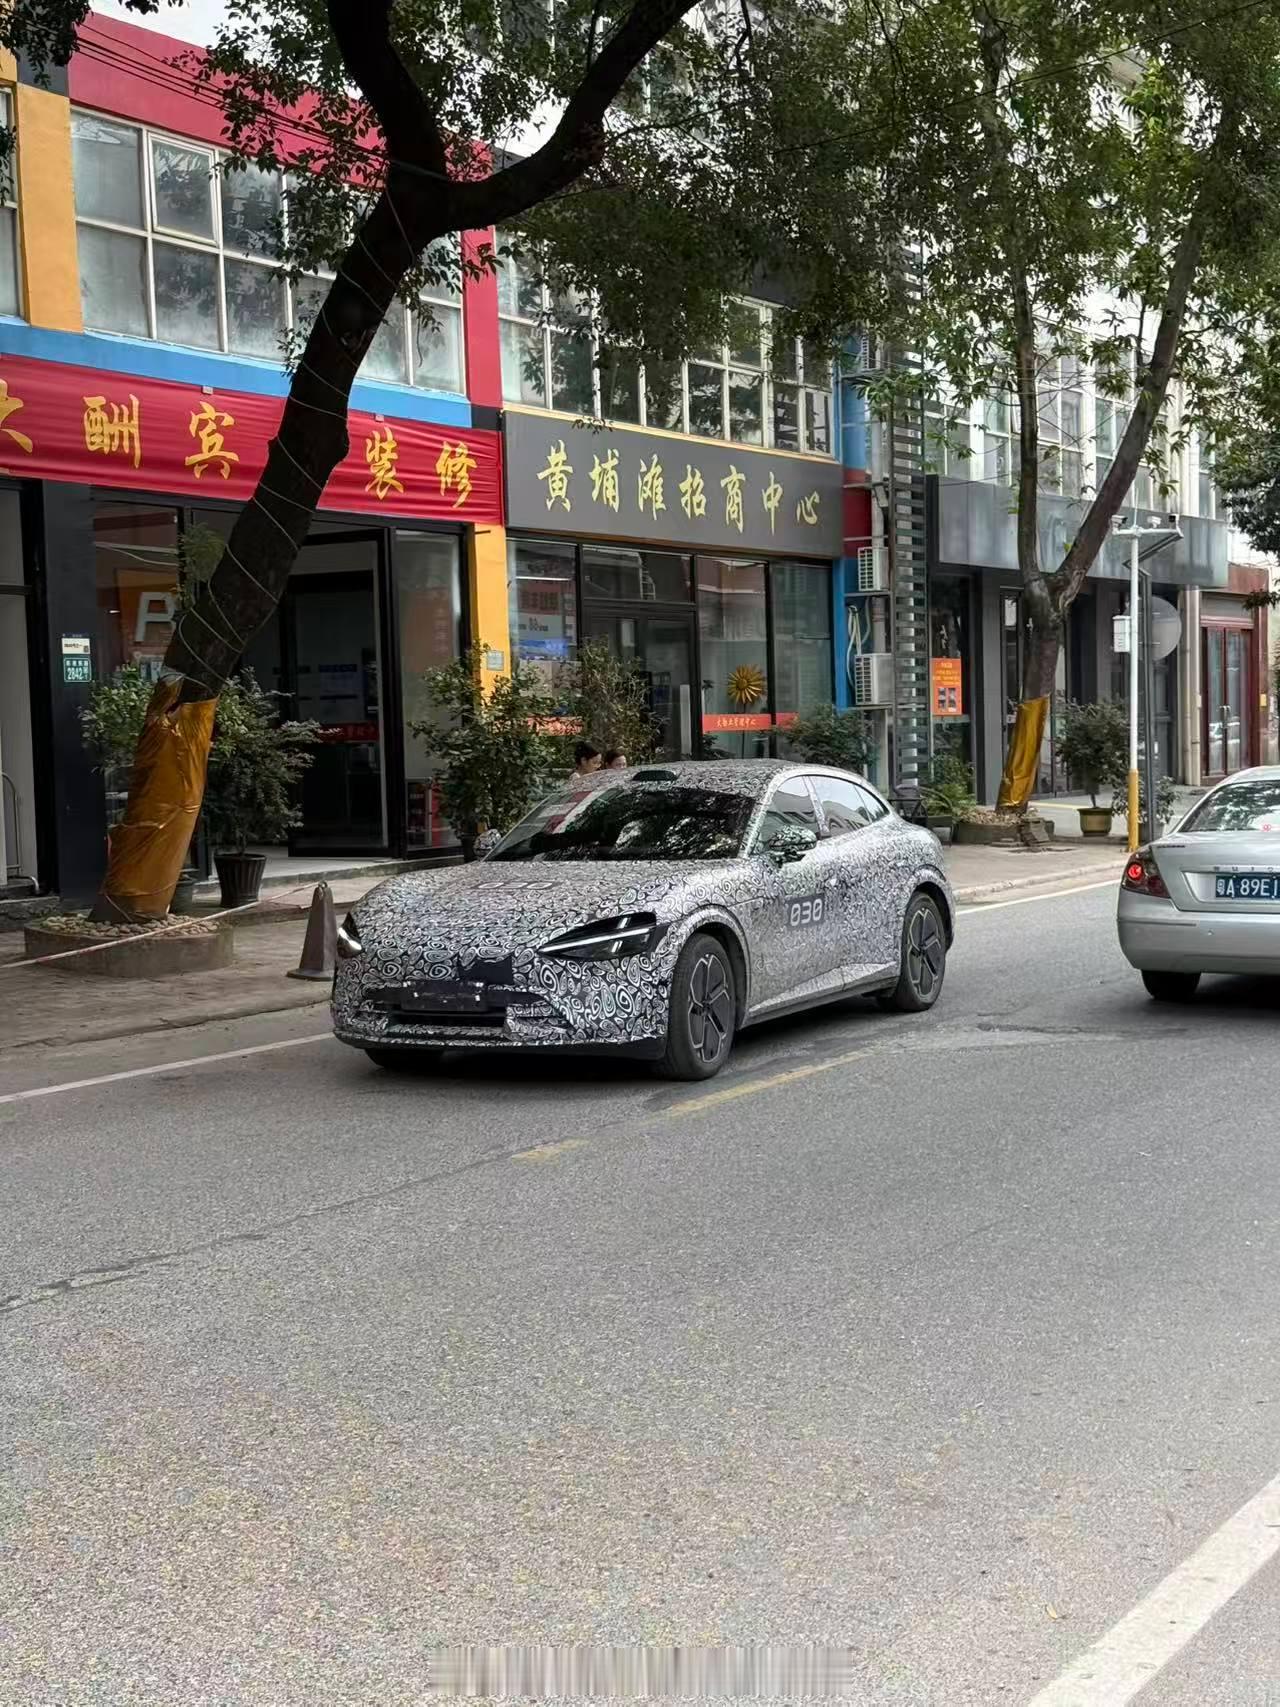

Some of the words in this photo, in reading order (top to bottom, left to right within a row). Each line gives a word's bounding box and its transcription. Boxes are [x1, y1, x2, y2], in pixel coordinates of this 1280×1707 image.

[364, 426, 478, 509] 装修
[536, 438, 821, 536] 黄埔滩招商中心
[789, 898, 823, 927] 030
